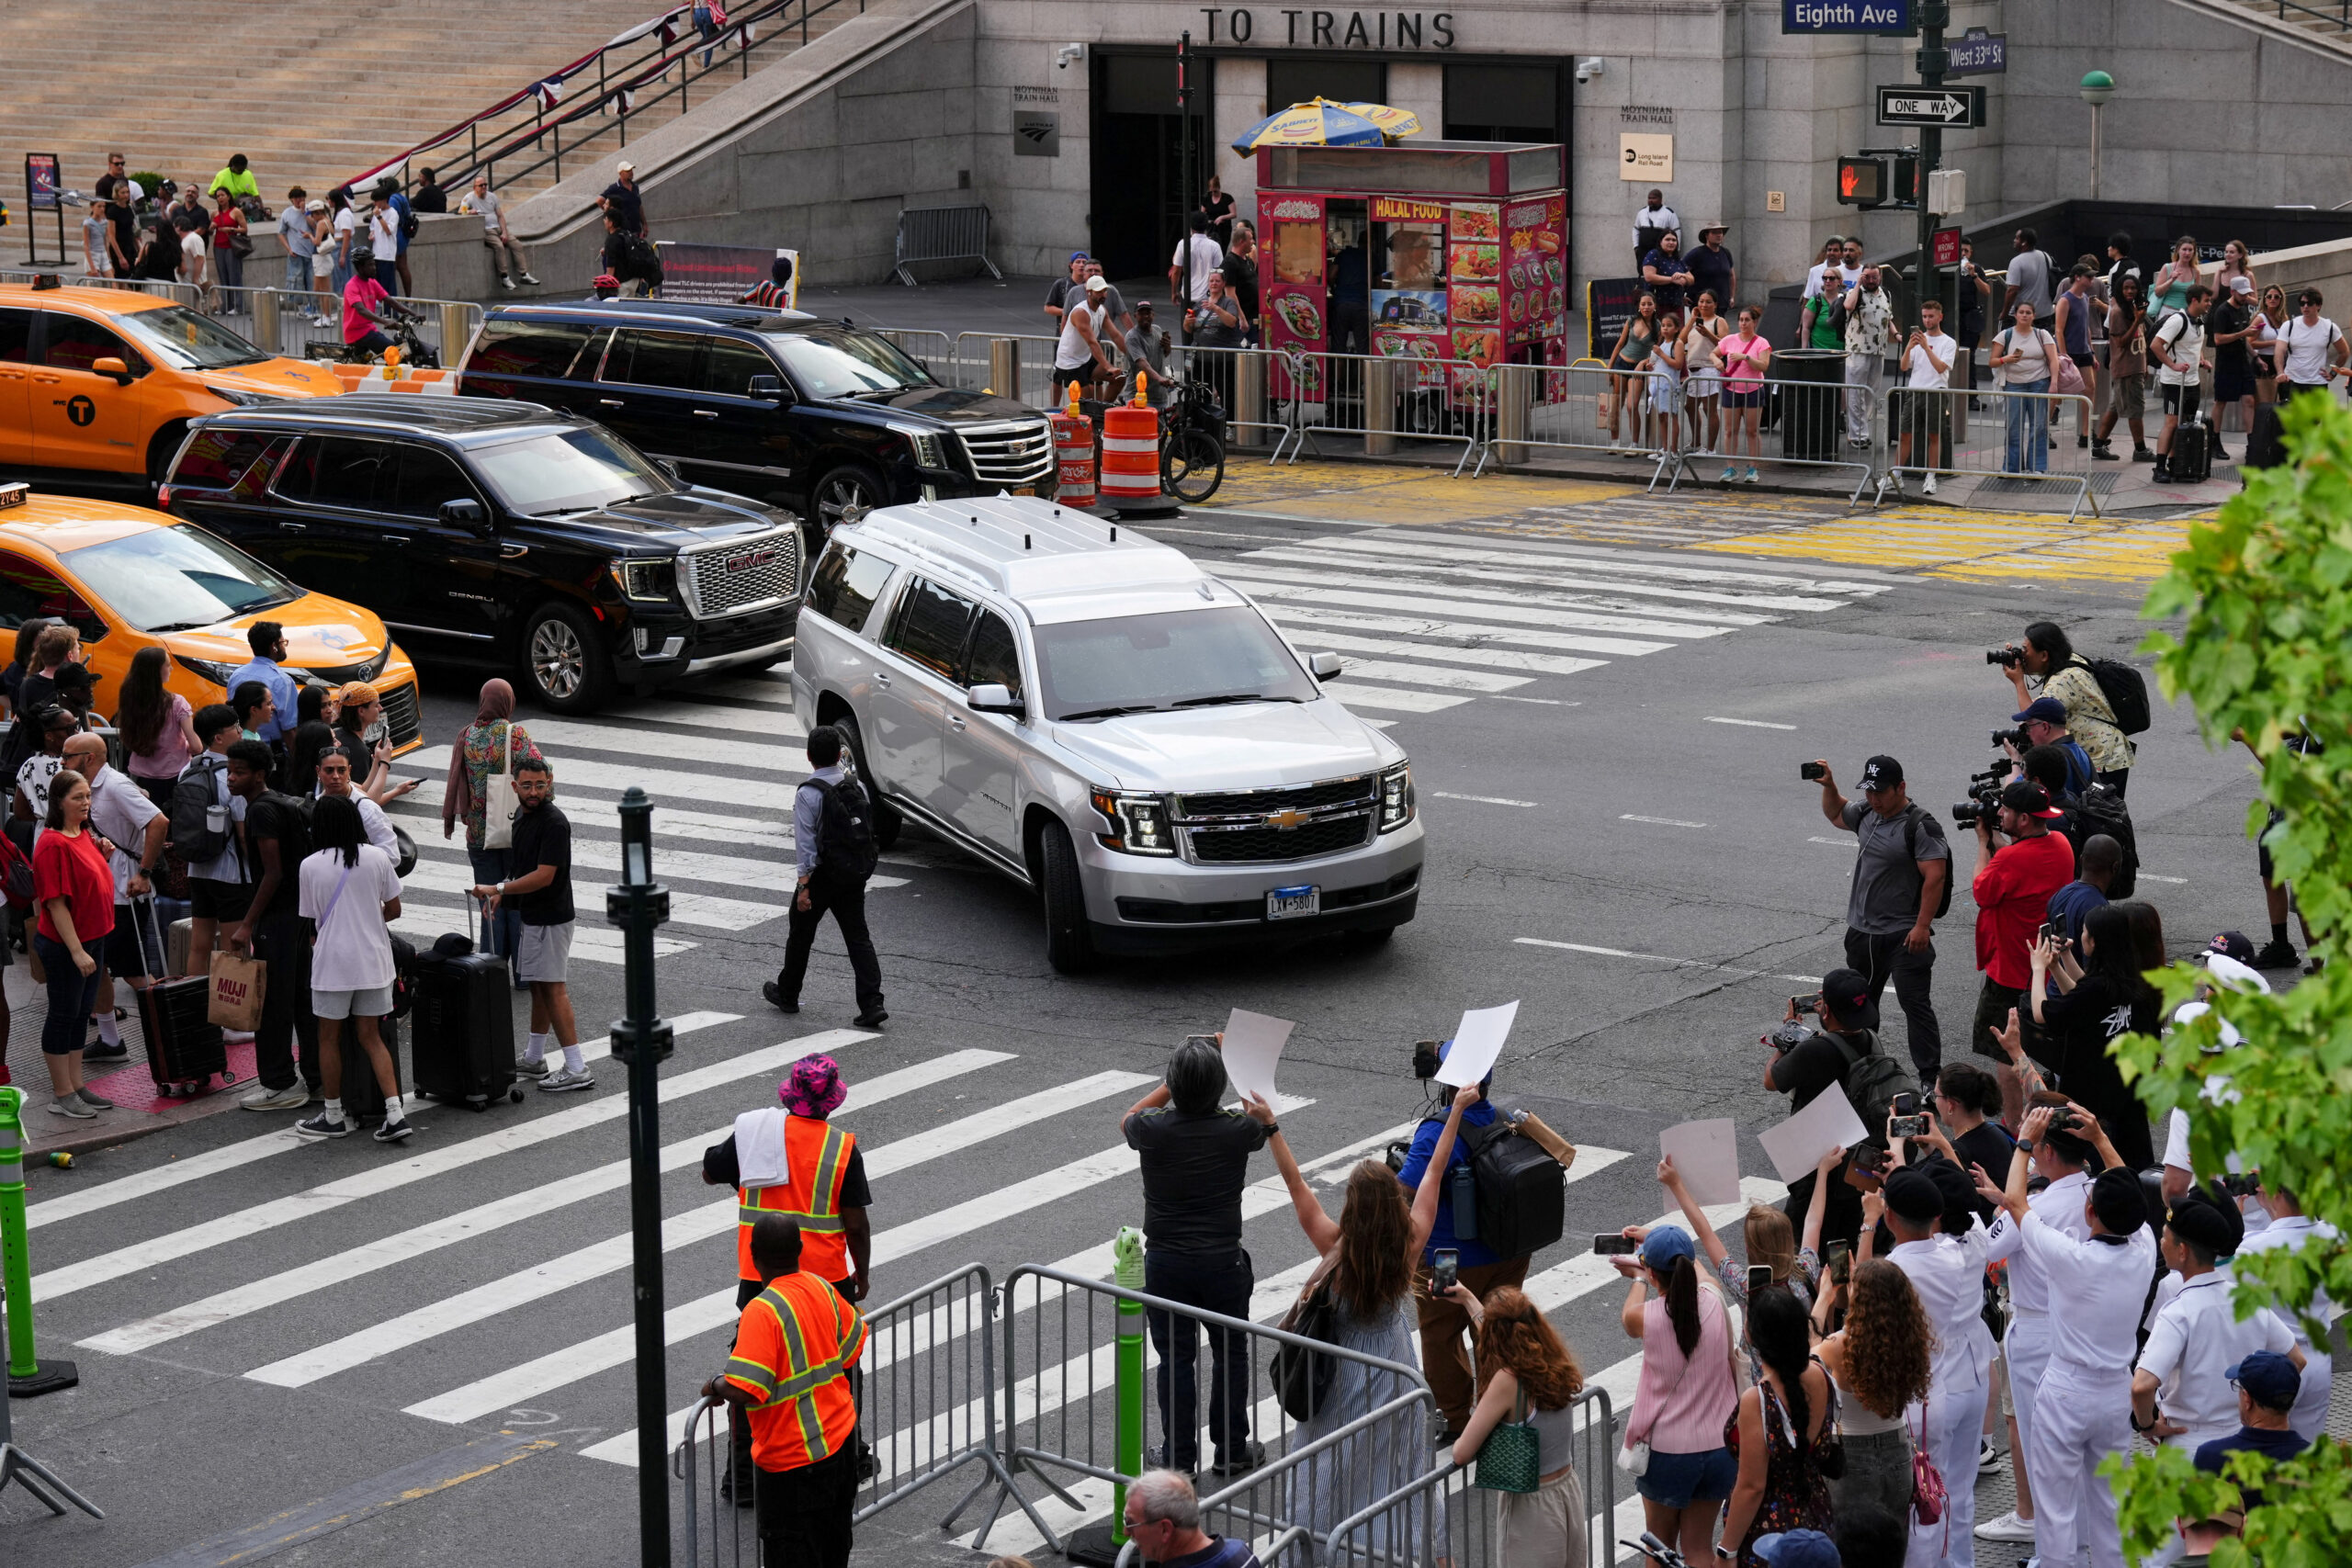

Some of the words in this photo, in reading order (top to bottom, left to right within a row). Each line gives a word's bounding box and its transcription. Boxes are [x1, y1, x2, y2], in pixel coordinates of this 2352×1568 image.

[1795, 4, 1854, 28] Eighth
[1860, 5, 1898, 24] Ave
[1200, 8, 1252, 44] TO
[1281, 10, 1455, 48] TRAINS
[1951, 47, 1973, 67] West
[1975, 44, 1991, 64] 33rd
[1993, 44, 2002, 63] St
[1014, 85, 1057, 94] MOYNIHAN
[1013, 94, 1037, 102] TRAIN
[1039, 95, 1059, 103] HALL
[1621, 105, 1672, 115] MOYNIHAN
[1894, 100, 1918, 113] ONE
[1930, 101, 1957, 114] WAY
[1270, 118, 1318, 134] SABRETT
[1620, 114, 1648, 123] TRAIN
[1650, 115, 1673, 124] HALL
[1376, 199, 1410, 219] HALAL
[1413, 200, 1442, 220] FOOD
[1938, 243, 1954, 252] WRONG
[1940, 252, 1951, 261] WAY
[729, 550, 776, 571] GMC
[448, 591, 494, 603] DENALI
[1867, 763, 1881, 777] NY
[1294, 895, 1315, 910] 5807
[217, 976, 247, 998] MUJI
